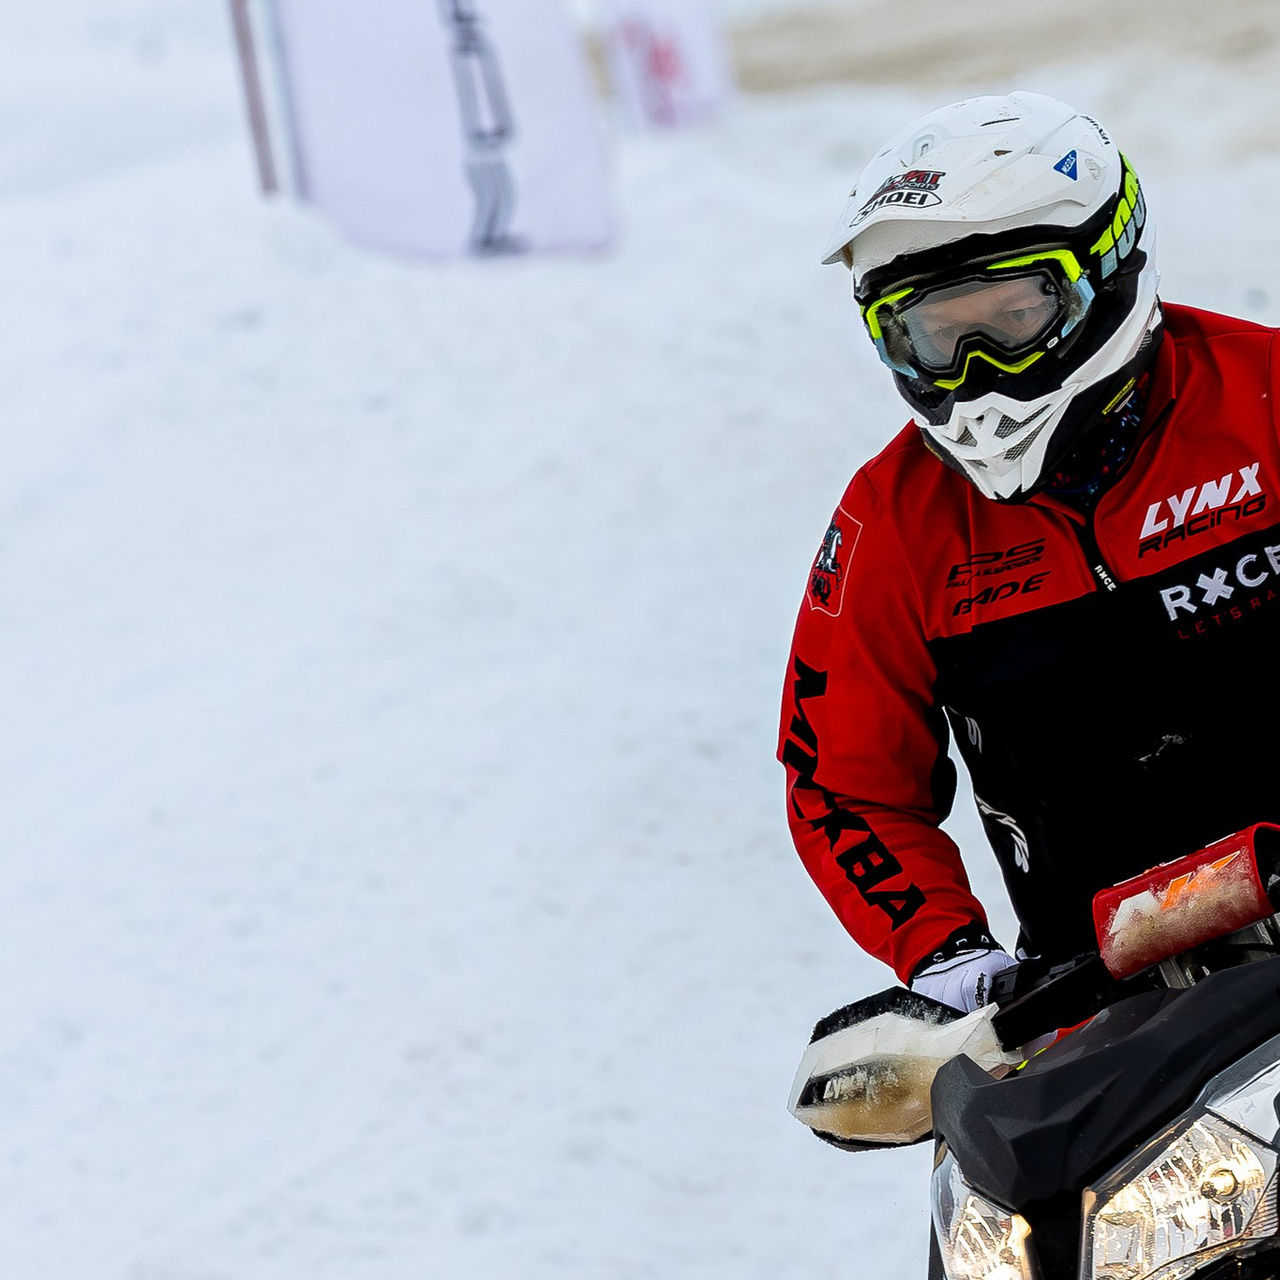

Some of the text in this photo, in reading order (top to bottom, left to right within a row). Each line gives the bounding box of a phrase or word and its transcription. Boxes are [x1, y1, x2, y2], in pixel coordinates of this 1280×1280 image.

[860, 191, 929, 217] SHOEI
[1138, 494, 1267, 560] RACING
[1139, 462, 1263, 540] LYNX
